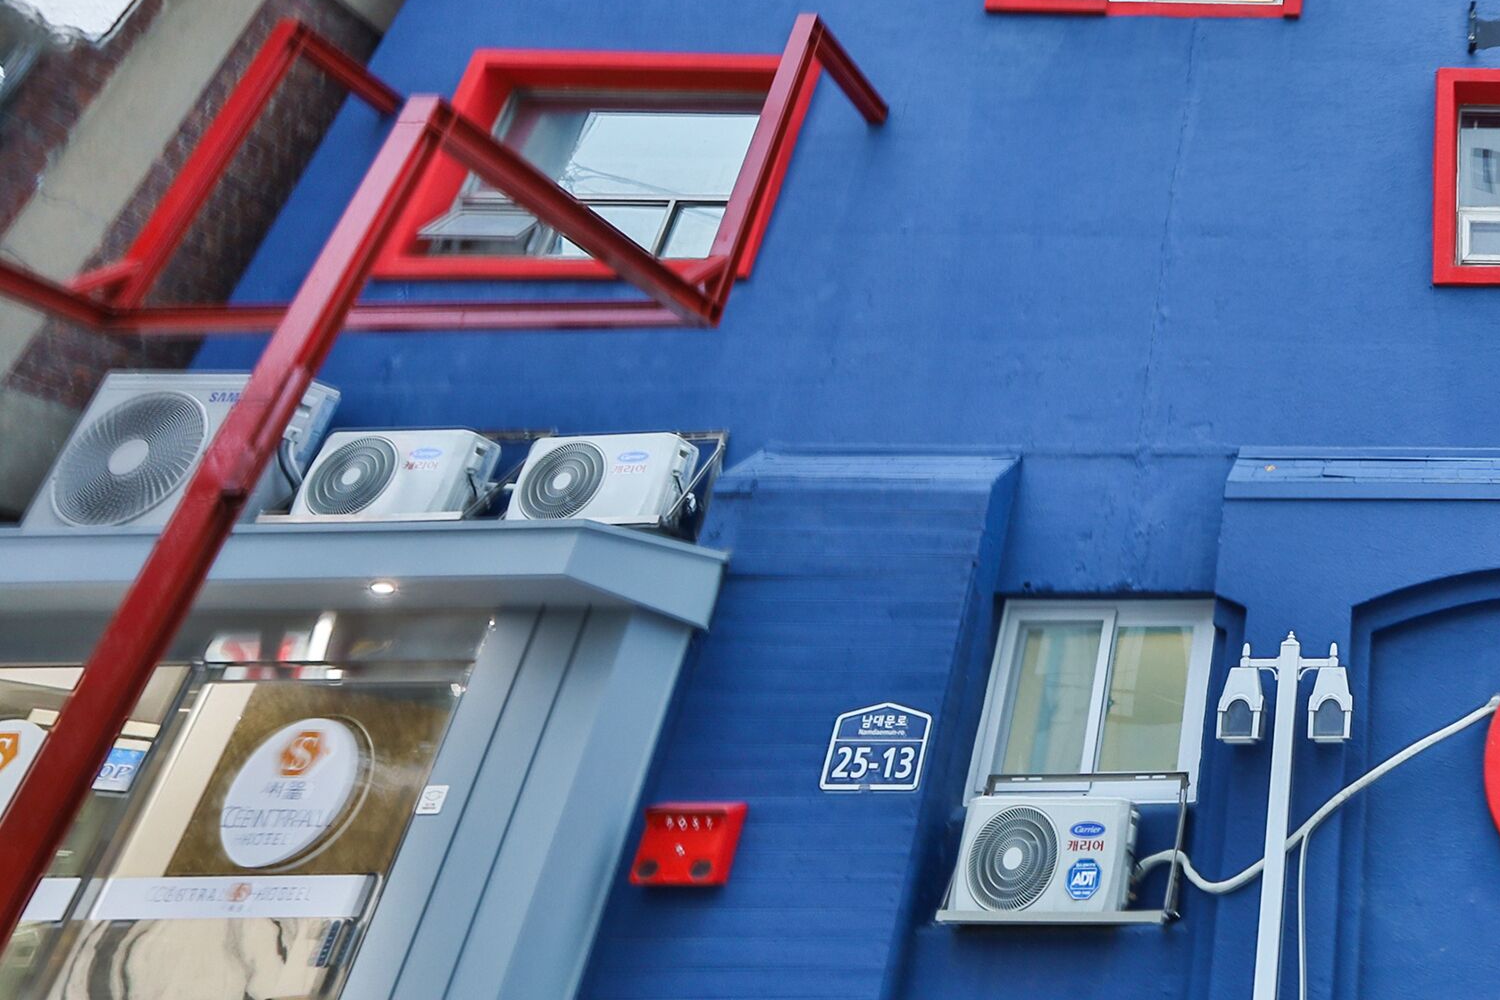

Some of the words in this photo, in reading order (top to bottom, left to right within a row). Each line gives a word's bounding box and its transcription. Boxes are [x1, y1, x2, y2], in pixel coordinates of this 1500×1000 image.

[862, 714, 907, 729] 남대문로
[831, 746, 915, 779] 25-13
[1074, 825, 1102, 834] Carrier
[1067, 840, 1104, 851] 캐리어
[1071, 871, 1097, 886] ADT
